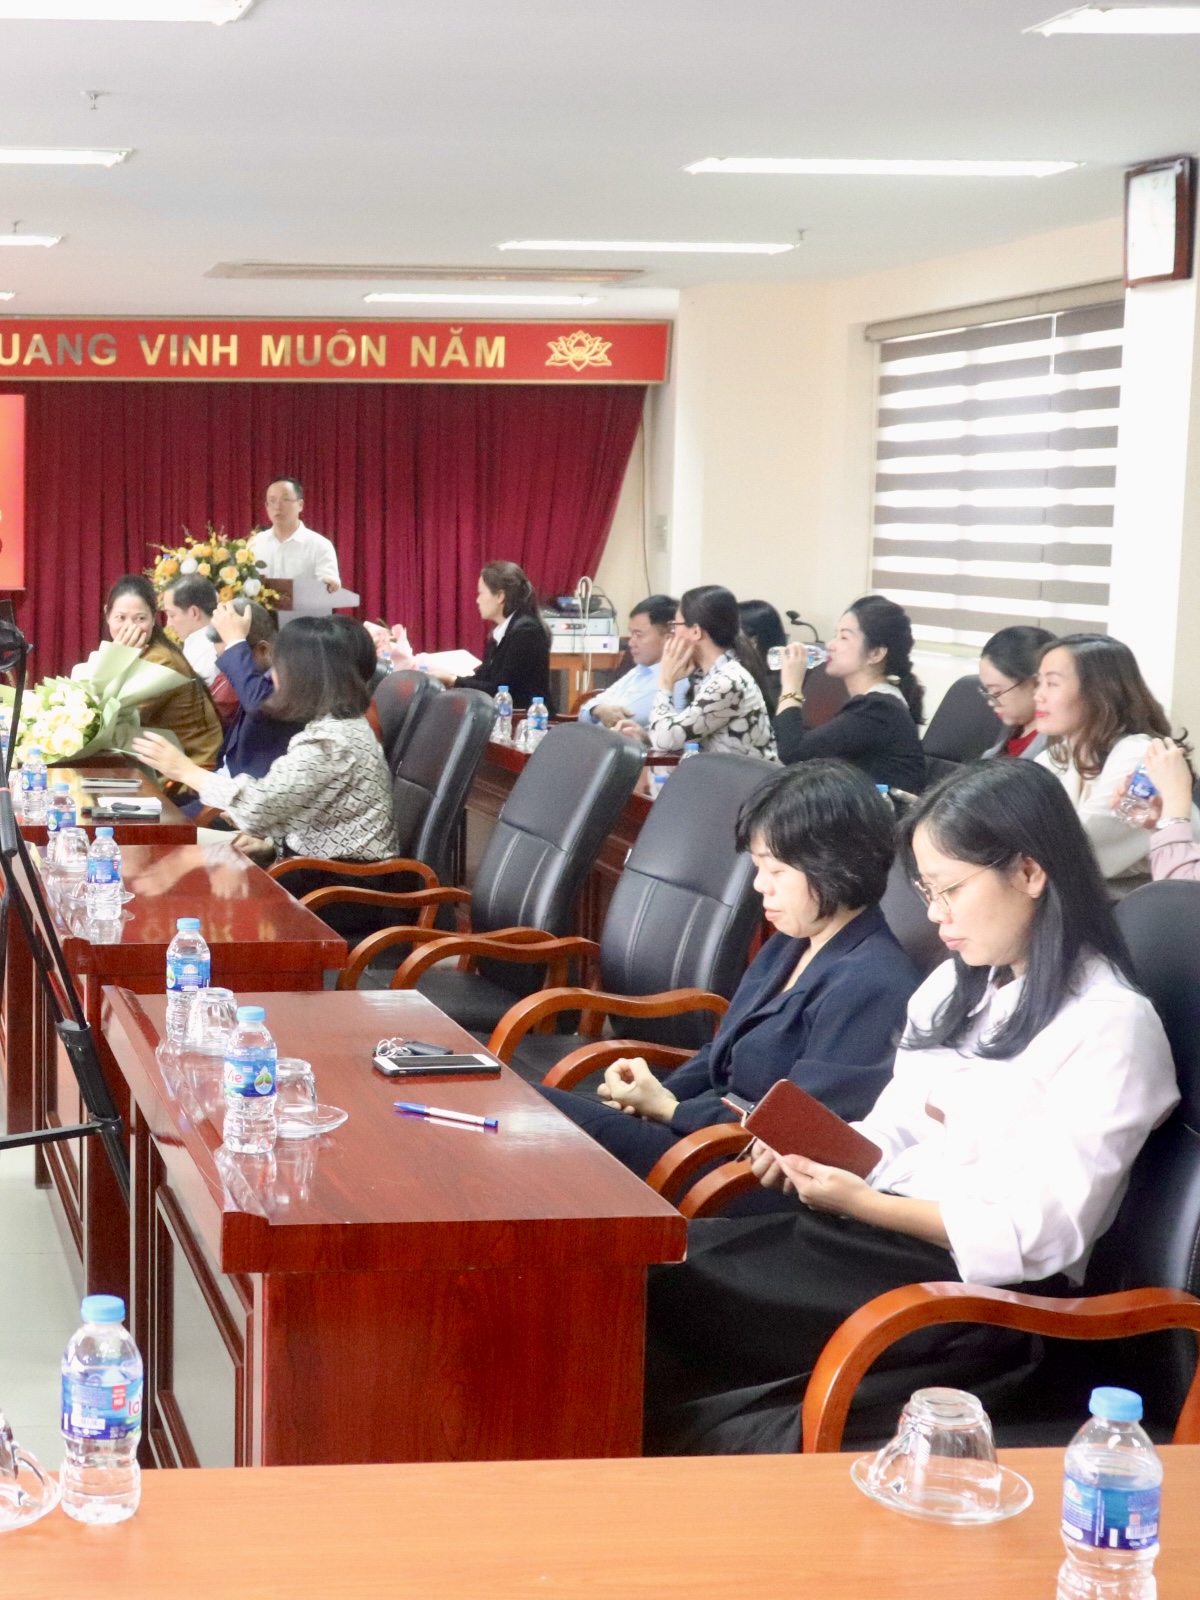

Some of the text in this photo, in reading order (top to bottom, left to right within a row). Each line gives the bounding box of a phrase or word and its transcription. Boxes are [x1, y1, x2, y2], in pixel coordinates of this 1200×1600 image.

[137, 333, 239, 367] VINH
[260, 328, 387, 368] MUÔN
[410, 326, 506, 369] NĂM
